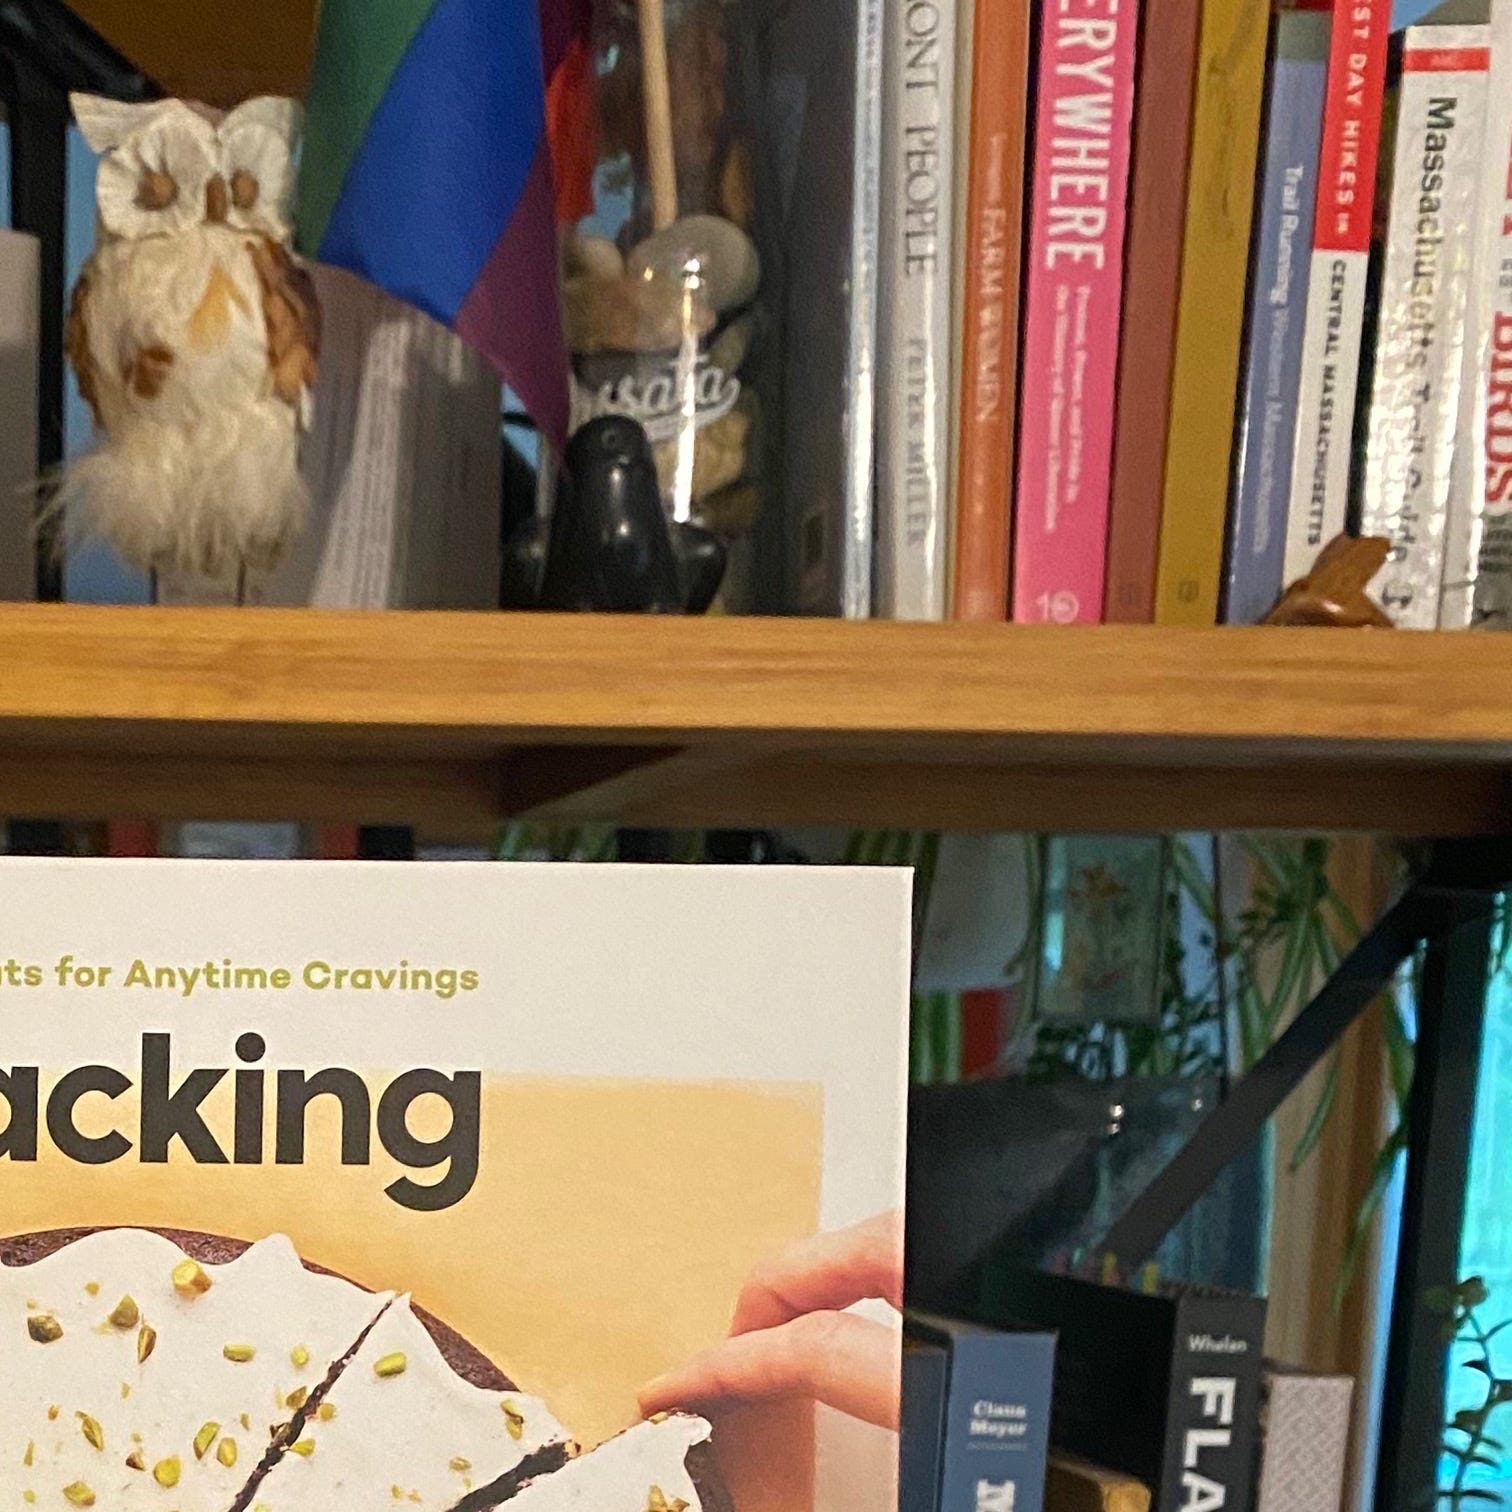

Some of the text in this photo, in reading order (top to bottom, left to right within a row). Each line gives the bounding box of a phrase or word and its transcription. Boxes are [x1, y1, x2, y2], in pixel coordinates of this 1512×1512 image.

[1345, 52, 1368, 108] DAY
[904, 0, 940, 280] ONT PEOPLE
[1335, 119, 1362, 206] HIKES
[1280, 164, 1304, 211] Trail
[978, 207, 1009, 296] FARM
[1268, 214, 1300, 305] Running
[1408, 97, 1459, 370] Massachusetts
[1307, 259, 1349, 546] CENTRAL MASSACHUSETTS
[54, 955, 113, 988] for
[124, 959, 292, 998] Anytime
[302, 960, 479, 999] Cravings
